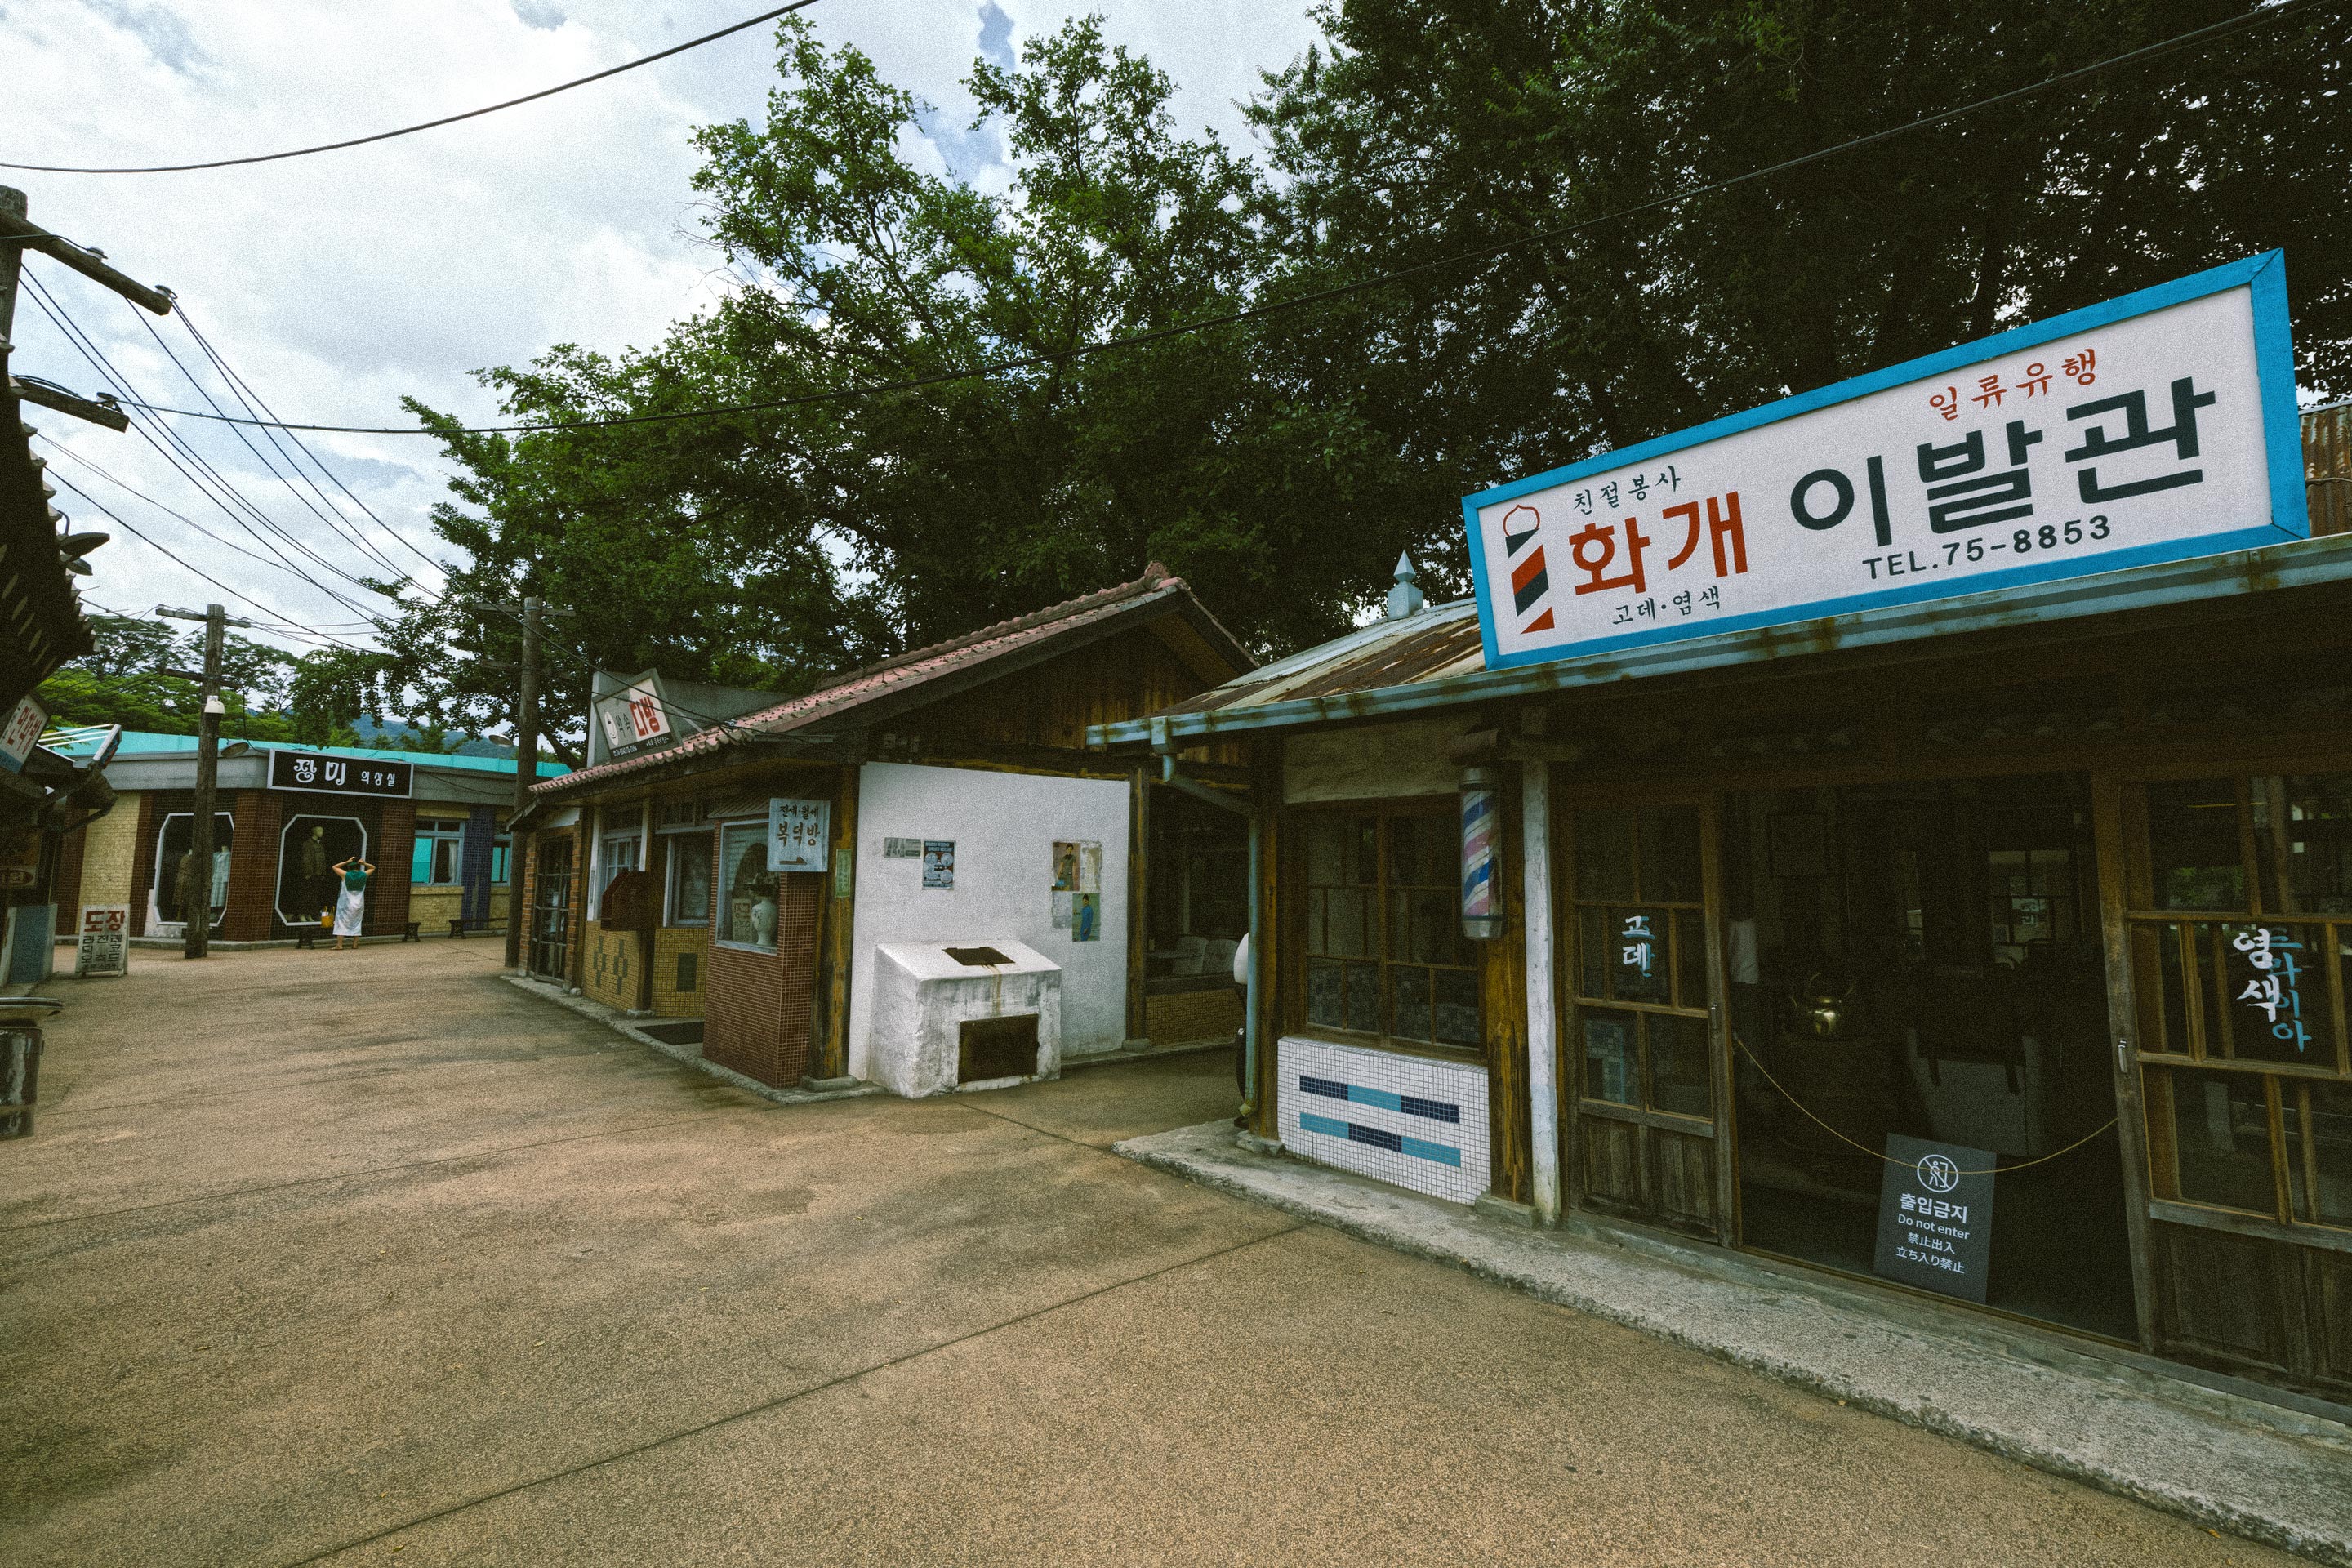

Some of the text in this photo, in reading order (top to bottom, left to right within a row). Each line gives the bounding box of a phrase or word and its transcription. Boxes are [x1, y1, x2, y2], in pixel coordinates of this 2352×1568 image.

[1568, 376, 2216, 596] 화개 이발관
[1861, 514, 2111, 580] TEL.75-8853
[629, 695, 661, 737] 다방
[293, 759, 395, 787] 장미 의상실
[777, 821, 820, 847] 복덕방
[84, 910, 126, 933] 도장
[81, 935, 95, 964] 라디오
[1621, 915, 1650, 972] 고데
[2233, 928, 2280, 1022] 염색
[1900, 1192, 1968, 1224] 출입금지
[1898, 1214, 1970, 1240] Do not enter
[1907, 1232, 1956, 1254] 禁止出入
[1895, 1246, 1965, 1274] 立ち入り禁止
